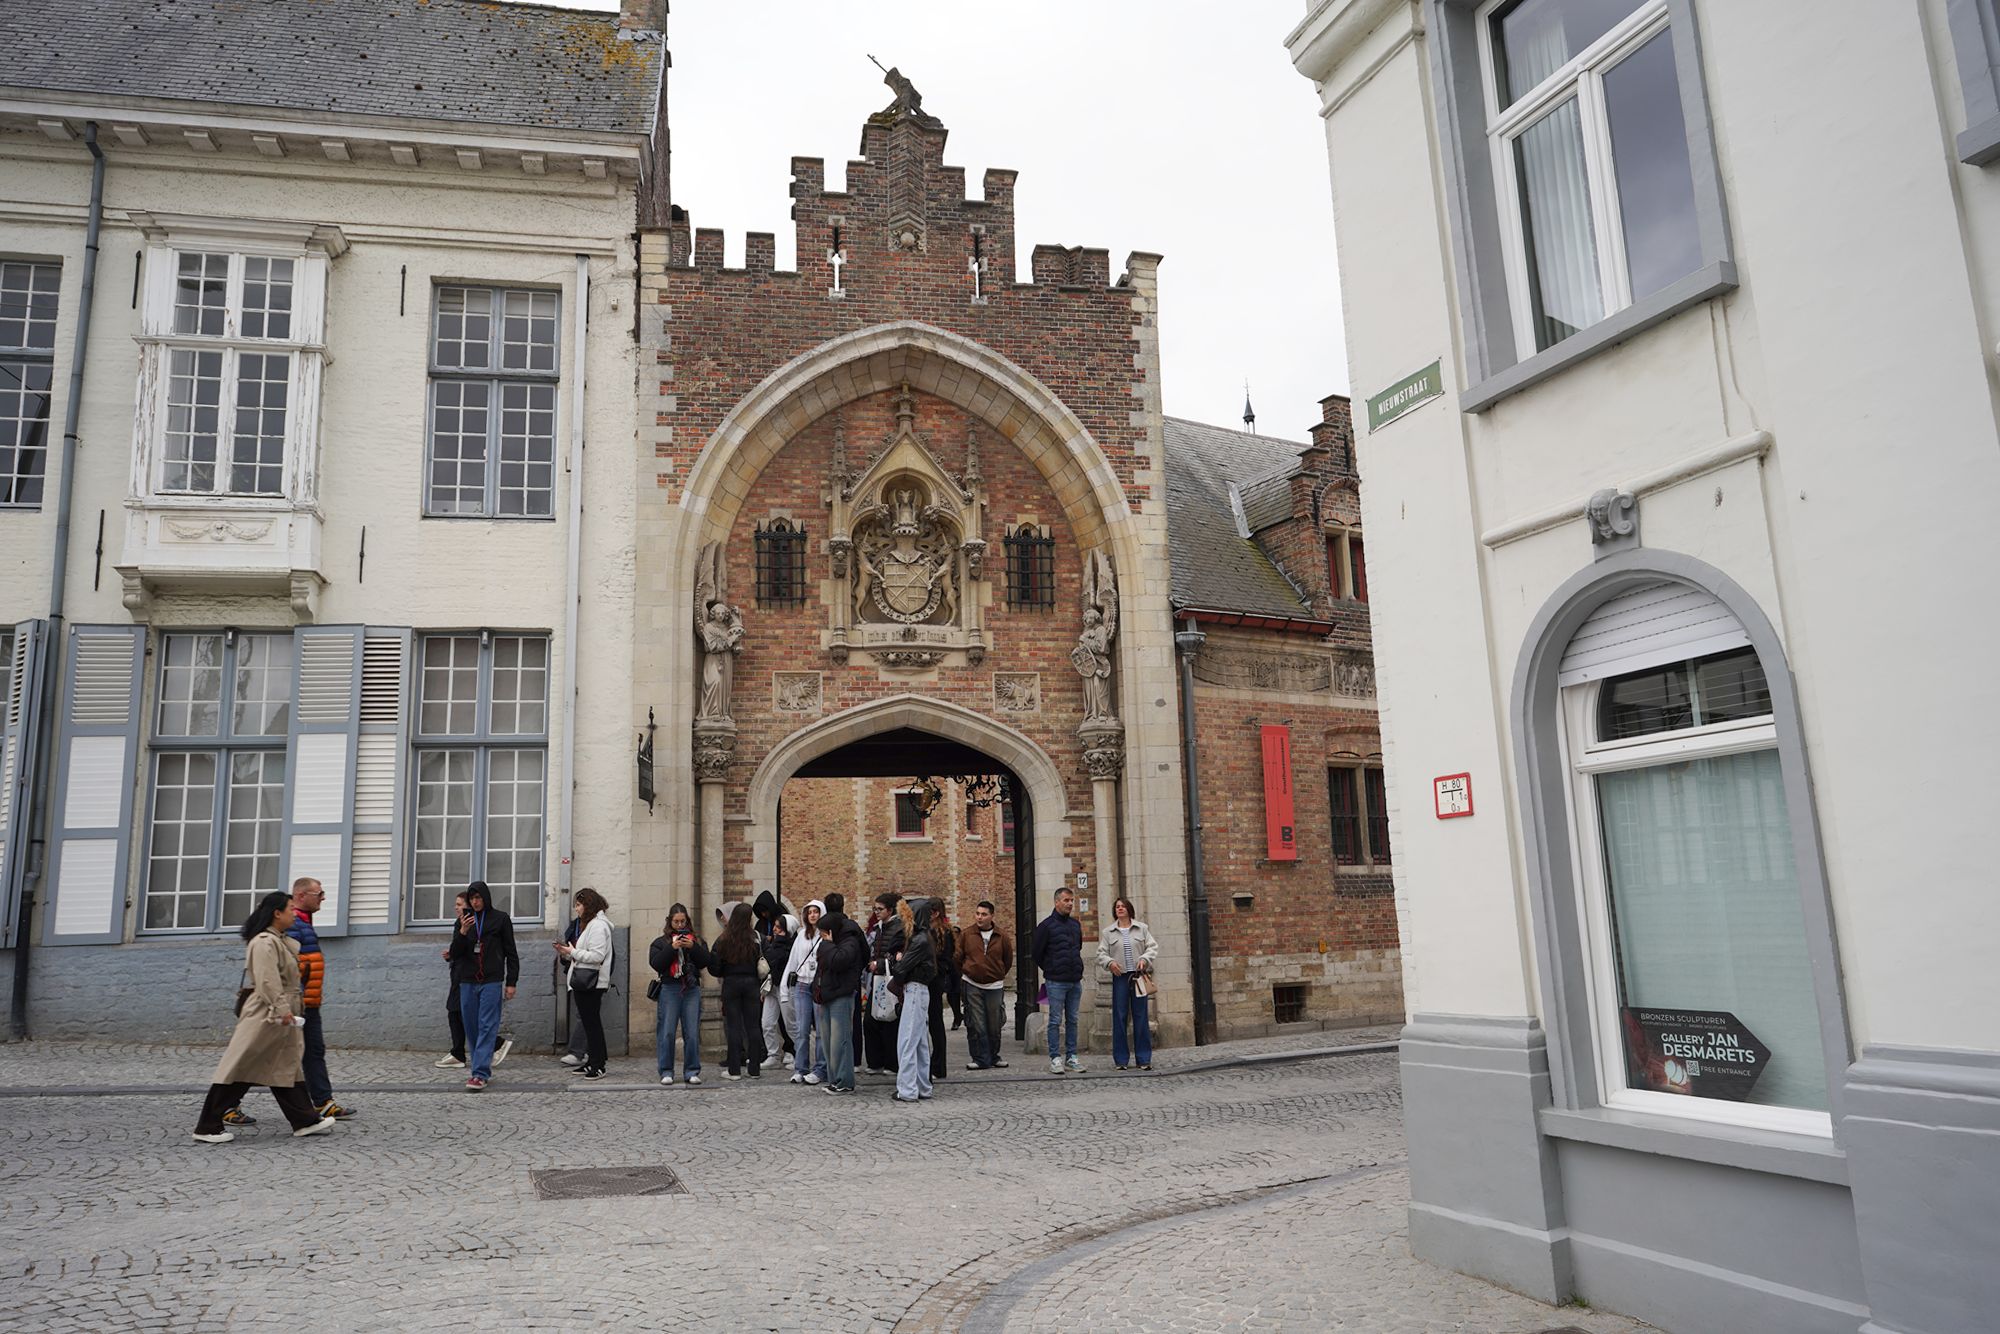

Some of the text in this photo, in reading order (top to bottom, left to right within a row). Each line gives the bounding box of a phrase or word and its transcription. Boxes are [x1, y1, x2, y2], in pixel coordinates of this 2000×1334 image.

[1378, 377, 1428, 415] NIEUWSTRAAT
[1442, 779, 1460, 790] H 80
[1281, 826, 1293, 841] B
[1079, 877, 1086, 885] 17
[1640, 1013, 1726, 1025] BRONZEN SCULPTUREN
[1661, 1032, 1739, 1047] GALLERY JAN
[1663, 1043, 1756, 1063] DESMARETS
[1700, 1066, 1752, 1077] FREE ENTRANCE
